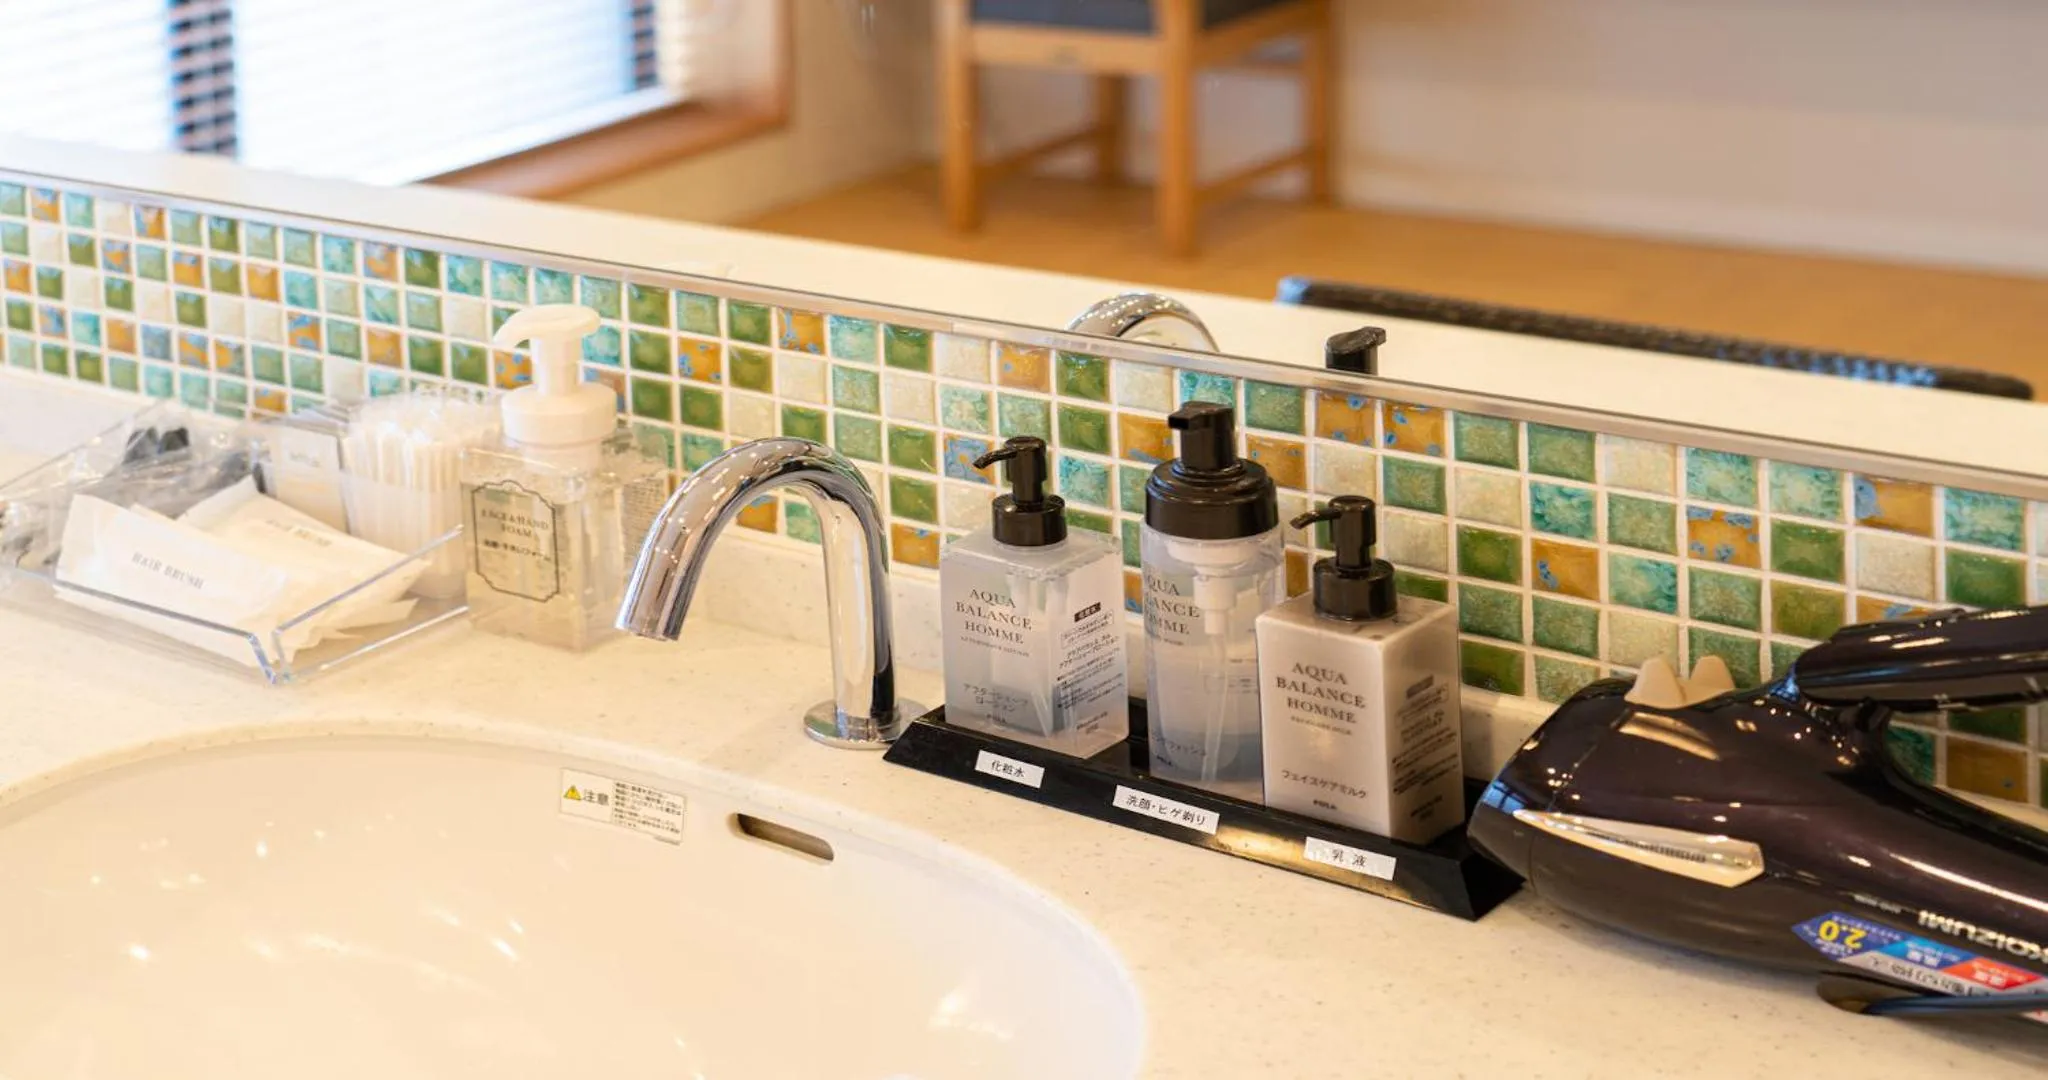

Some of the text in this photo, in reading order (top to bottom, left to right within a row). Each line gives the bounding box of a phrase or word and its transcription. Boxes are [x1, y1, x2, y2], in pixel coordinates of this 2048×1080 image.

[131, 552, 205, 590] HAIR BRUSH
[1147, 574, 1180, 596] QUA
[970, 588, 1016, 609] AQUA
[955, 601, 1032, 631] BALANCE
[965, 620, 1023, 645] HOMME
[1291, 662, 1347, 685] AQUA
[1276, 676, 1366, 709] BALANCE
[1287, 696, 1357, 724] HOMME
[991, 760, 1025, 778] 化粧水
[1282, 770, 1366, 798] フェイスケアミルク
[1126, 795, 1205, 826] 洗顔・ヒゲ剃り
[1819, 920, 1867, 949] 2.0
